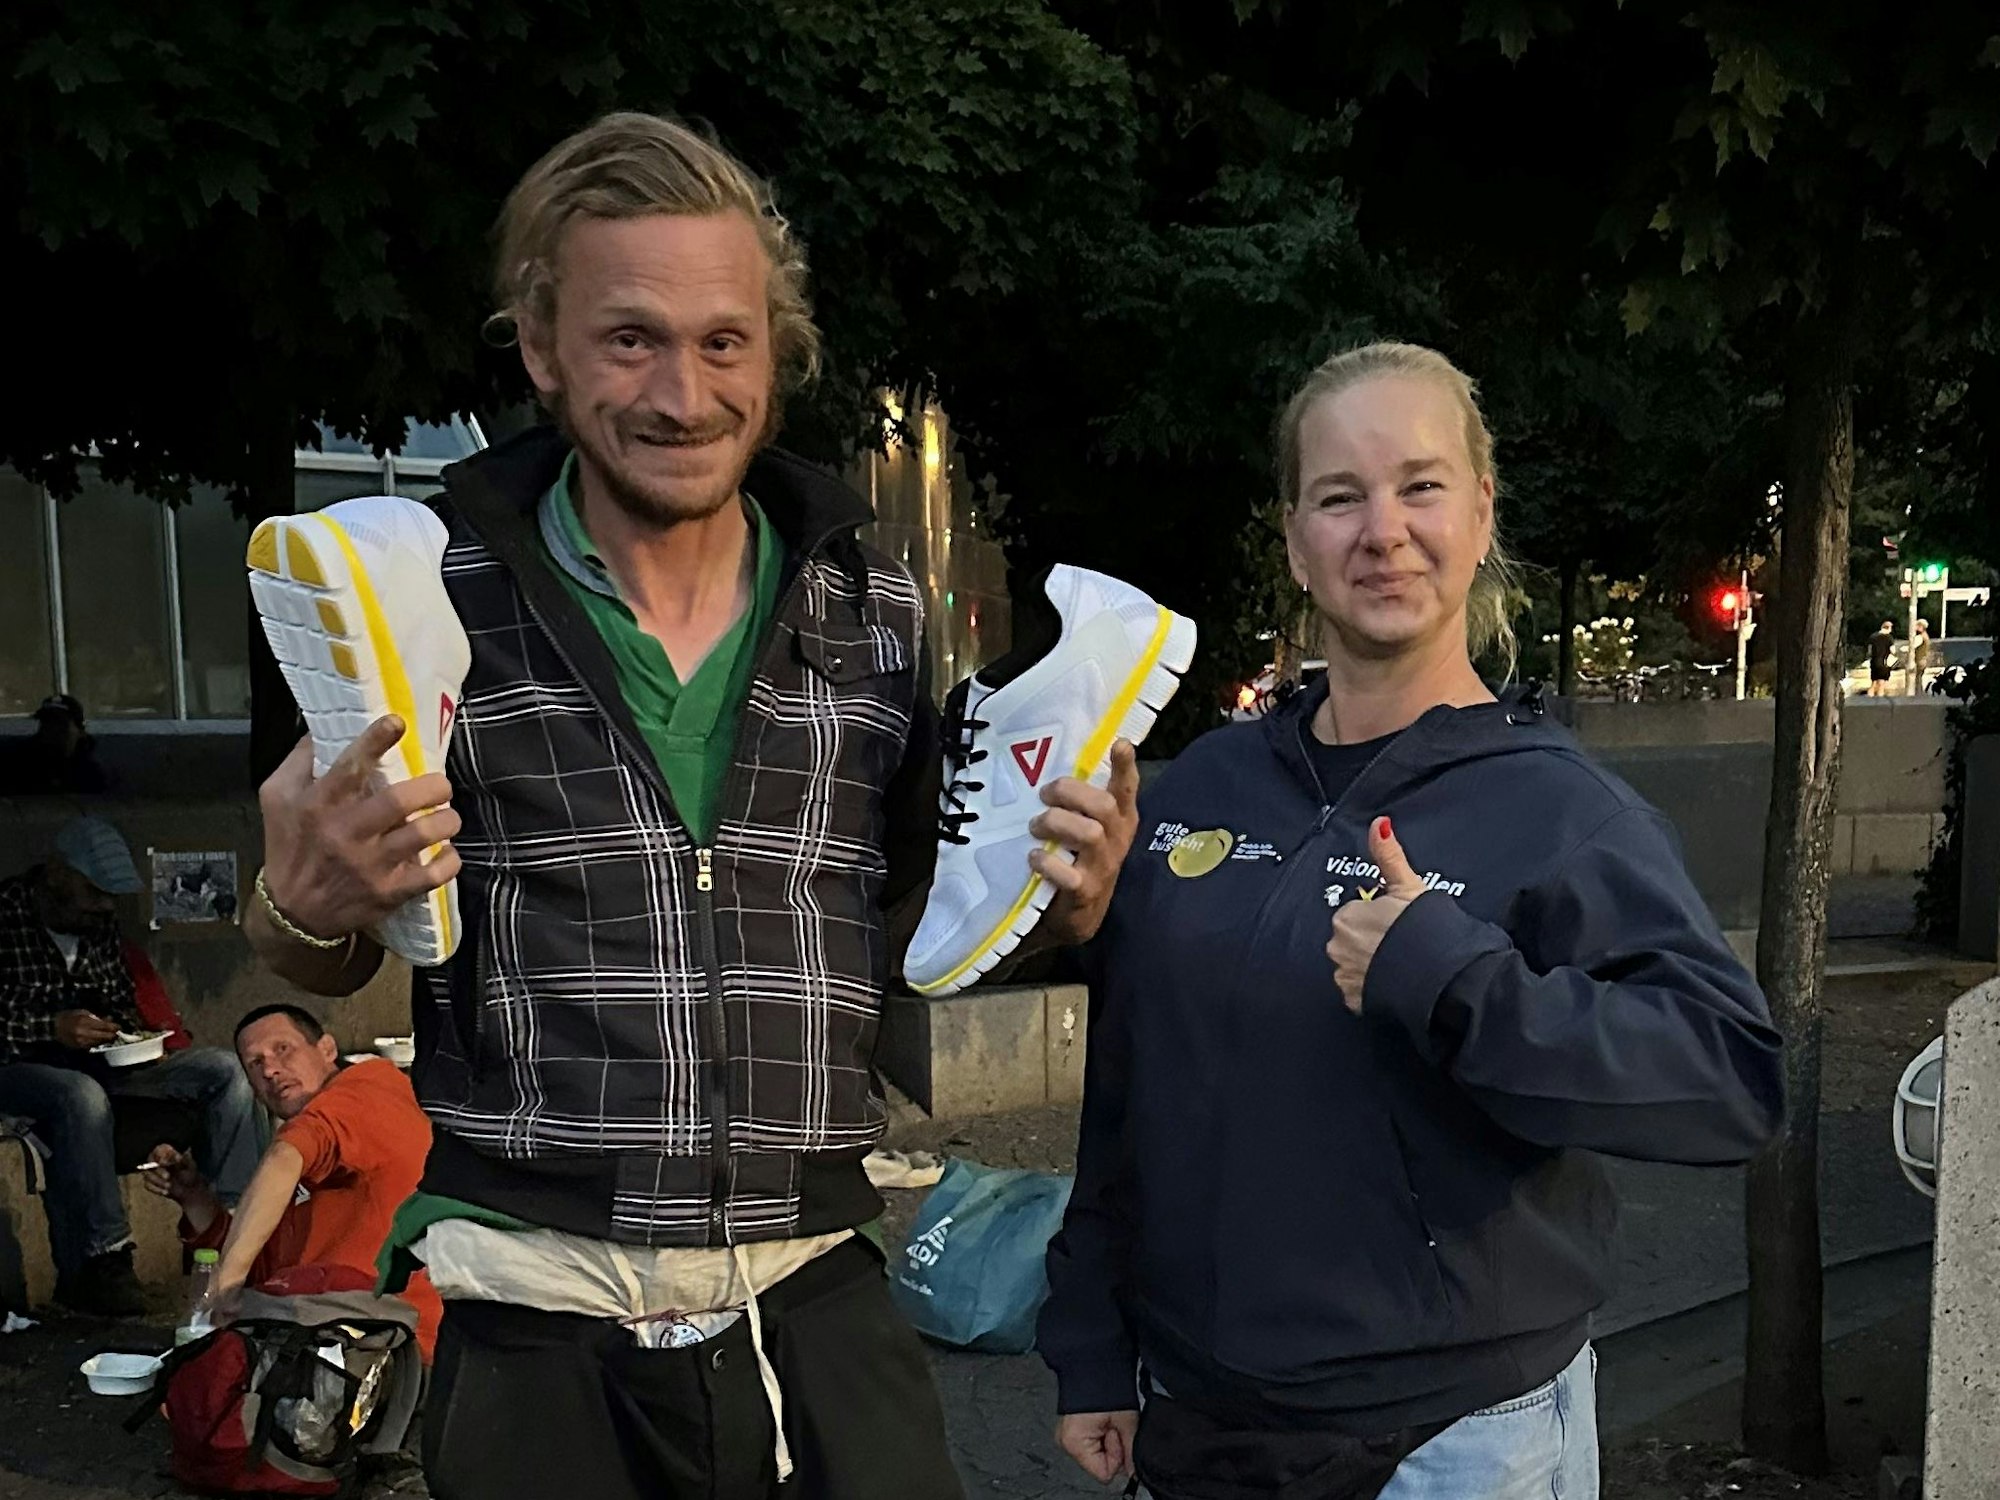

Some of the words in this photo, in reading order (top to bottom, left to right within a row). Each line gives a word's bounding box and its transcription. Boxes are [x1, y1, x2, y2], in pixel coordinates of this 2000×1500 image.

[1155, 822, 1190, 836] gute
[1147, 837, 1174, 853] bus
[1163, 832, 1205, 853] nacht
